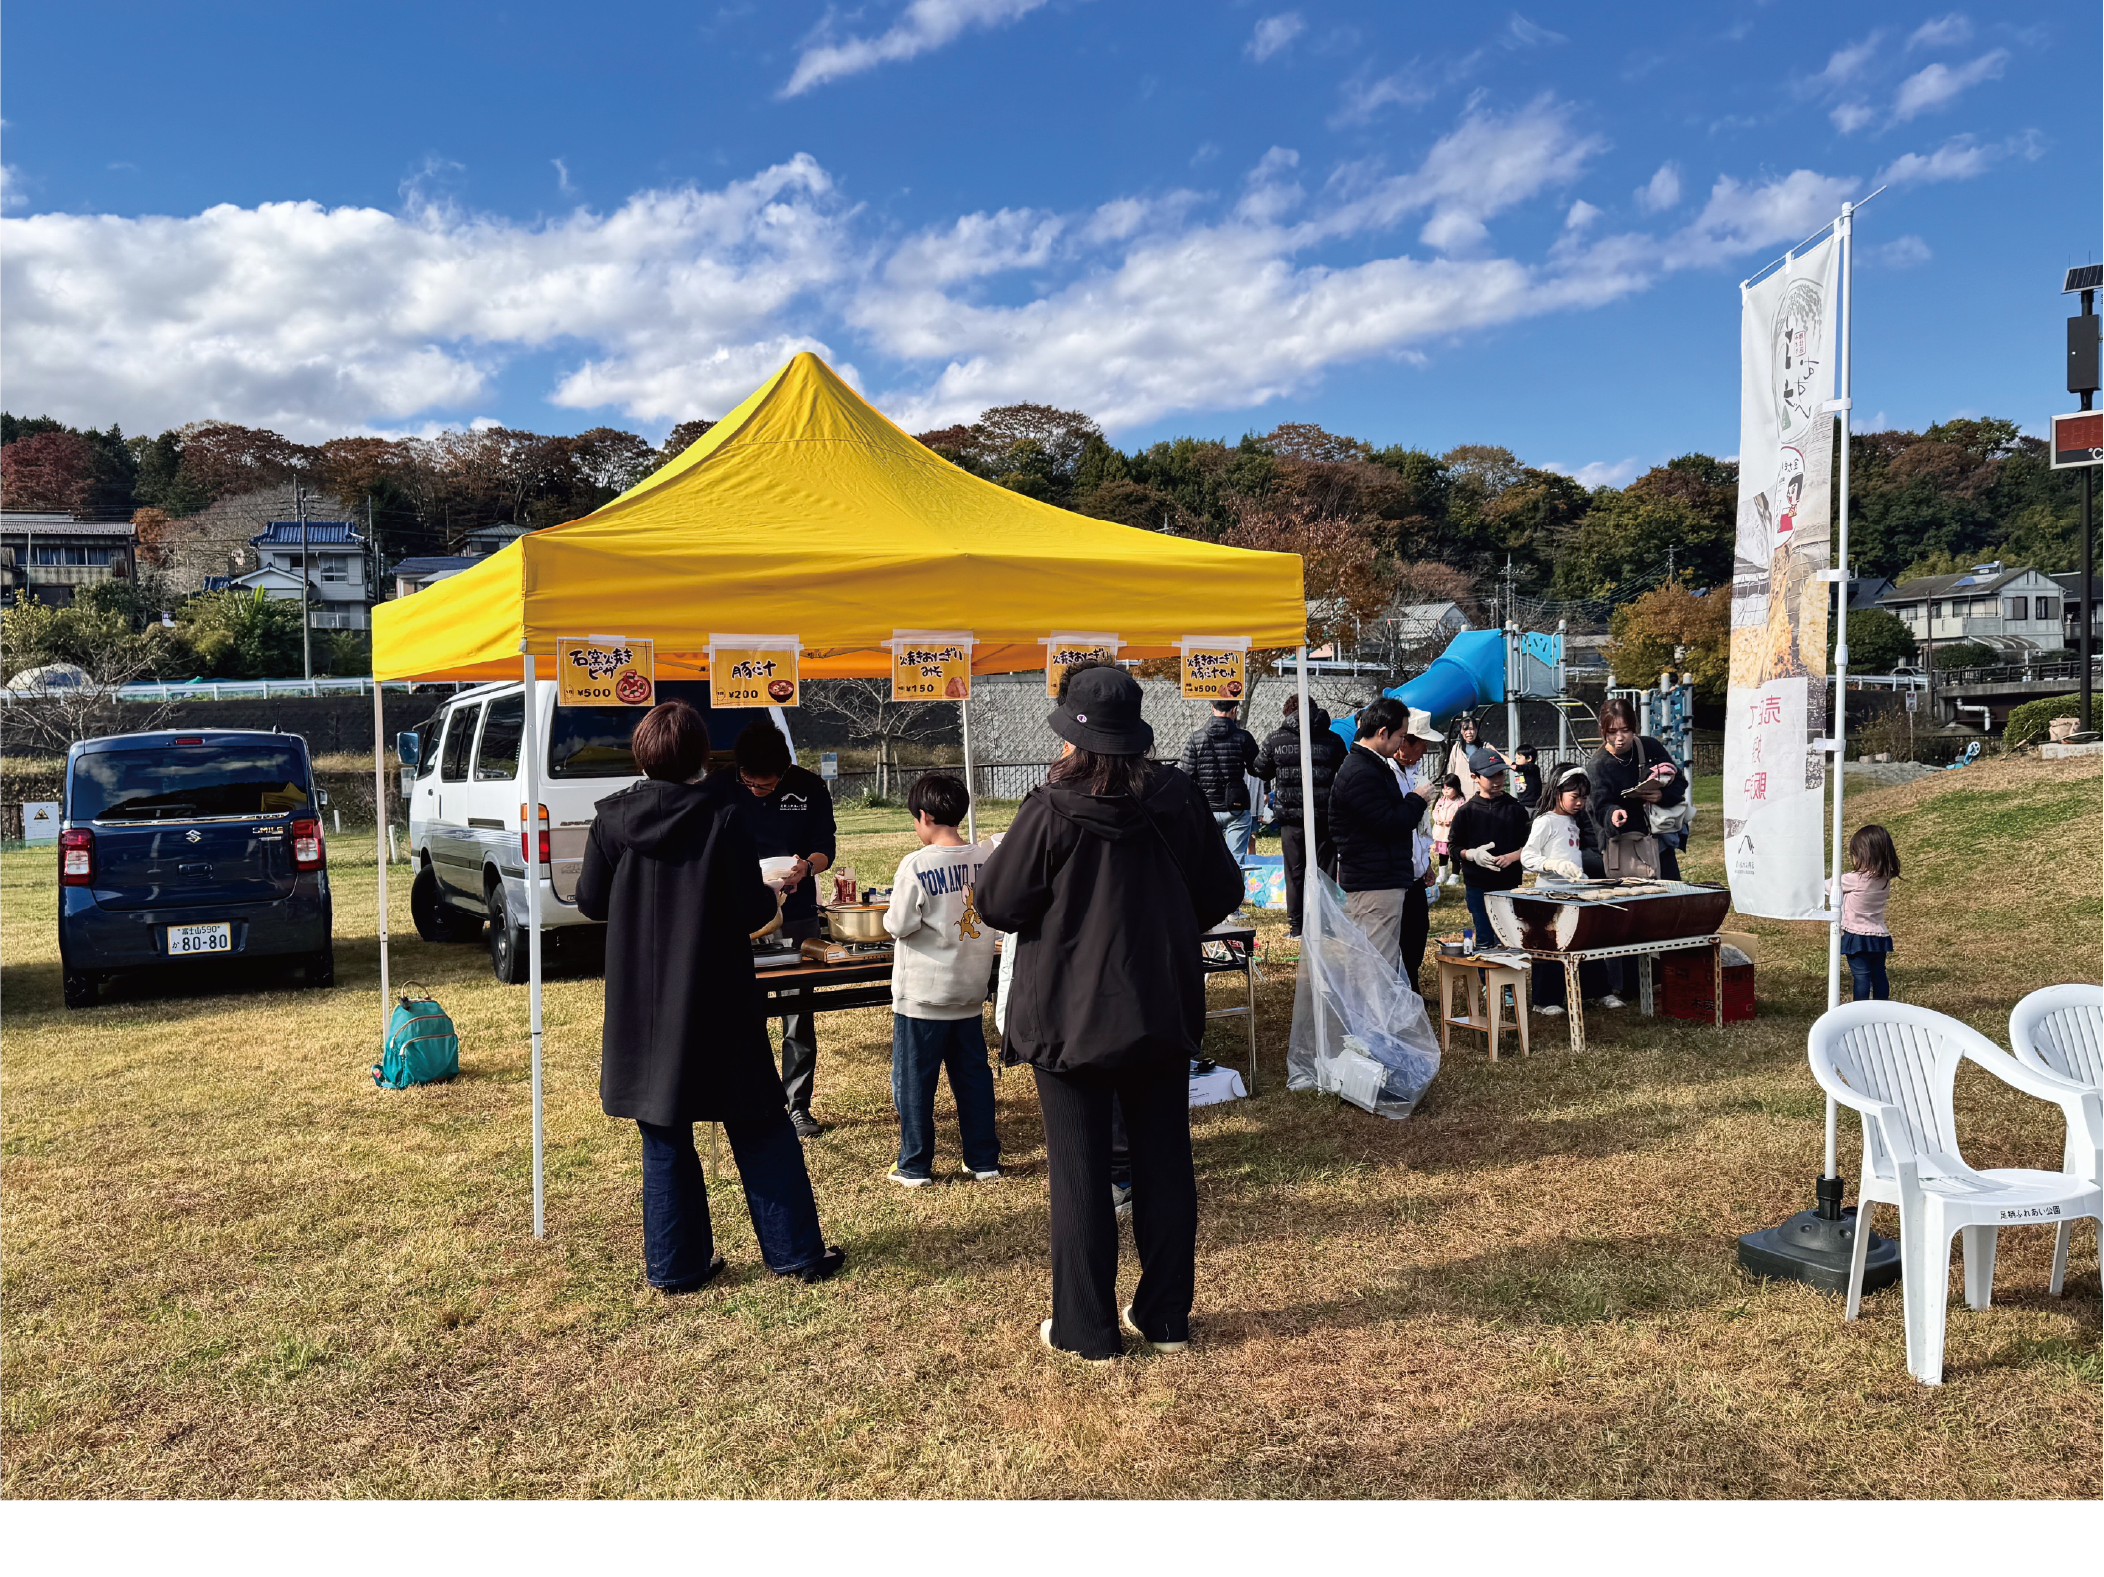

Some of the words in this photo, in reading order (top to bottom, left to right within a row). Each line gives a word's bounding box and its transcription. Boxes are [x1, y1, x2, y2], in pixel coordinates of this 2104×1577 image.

[569, 647, 633, 667] 石窯焼き
[899, 647, 963, 666] 焼きおにぎり
[1187, 652, 1239, 668] 焼きおにぎり
[588, 665, 618, 680] ピザ
[731, 660, 777, 679] 豚汁
[920, 665, 943, 677] みそ
[577, 688, 611, 698] ¥500
[728, 689, 759, 699] ¥200
[906, 684, 934, 693] ¥150
[1194, 685, 1217, 693] ¥500
[917, 867, 949, 896] TOM
[948, 863, 969, 893] AND
[182, 934, 228, 951] 80-80
[2000, 1205, 2061, 1220] 足柄ふれあい公園
